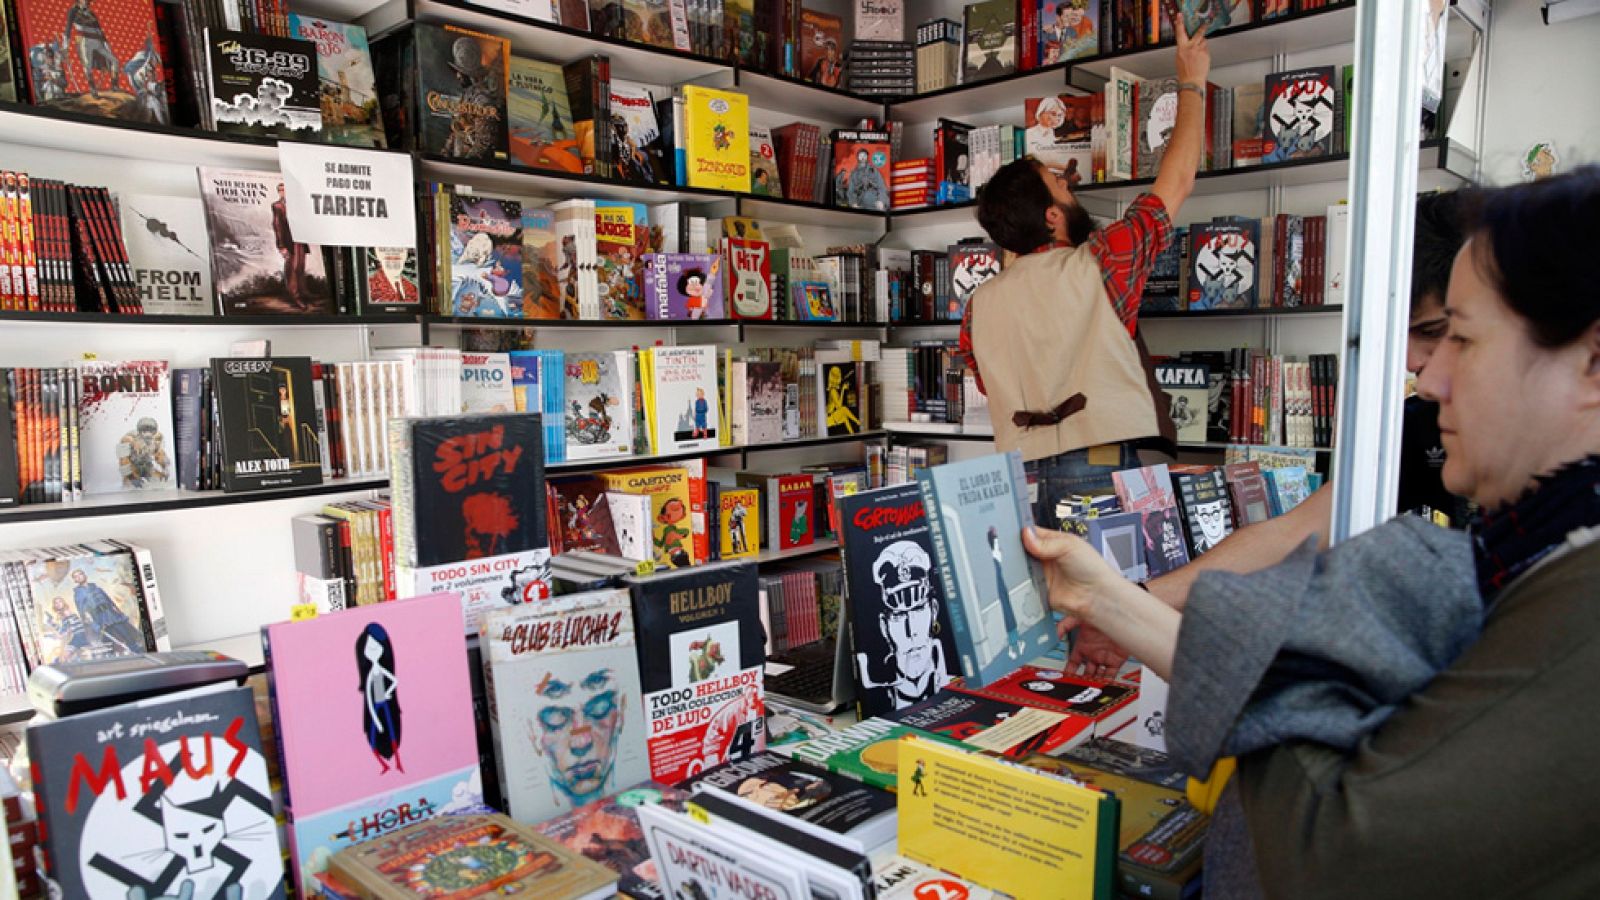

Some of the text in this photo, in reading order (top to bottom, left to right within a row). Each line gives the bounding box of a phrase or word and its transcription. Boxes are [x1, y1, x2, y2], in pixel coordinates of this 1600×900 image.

[1268, 74, 1329, 102] MAUS
[324, 162, 372, 176] SE ADMITE
[326, 177, 372, 190] PAGO CON
[311, 193, 388, 218] TARJETA
[1195, 230, 1249, 250] MAUS
[136, 269, 201, 287] FROM
[654, 254, 669, 319] mafalda
[136, 285, 203, 301] HELL
[665, 356, 698, 364] TINTIN
[82, 375, 159, 393] RONIN
[1155, 368, 1206, 385] KAFKA
[433, 424, 505, 473] SIN
[235, 458, 290, 473] ALEX TOTH
[441, 445, 523, 493] CITY
[780, 482, 812, 493] BABAR
[431, 558, 520, 582] TODO SIN CITY
[670, 582, 735, 615] HELLBOY
[511, 622, 550, 655] CLUB
[562, 612, 608, 649] LUCHA
[609, 610, 623, 641] 2
[650, 671, 758, 709] TODO HELLBOY
[652, 710, 665, 720] EN
[667, 706, 686, 717] UNA
[652, 706, 712, 734] DE LUJO
[97, 722, 124, 743] art
[64, 715, 246, 815] MAUS
[665, 839, 721, 886] DARTH
